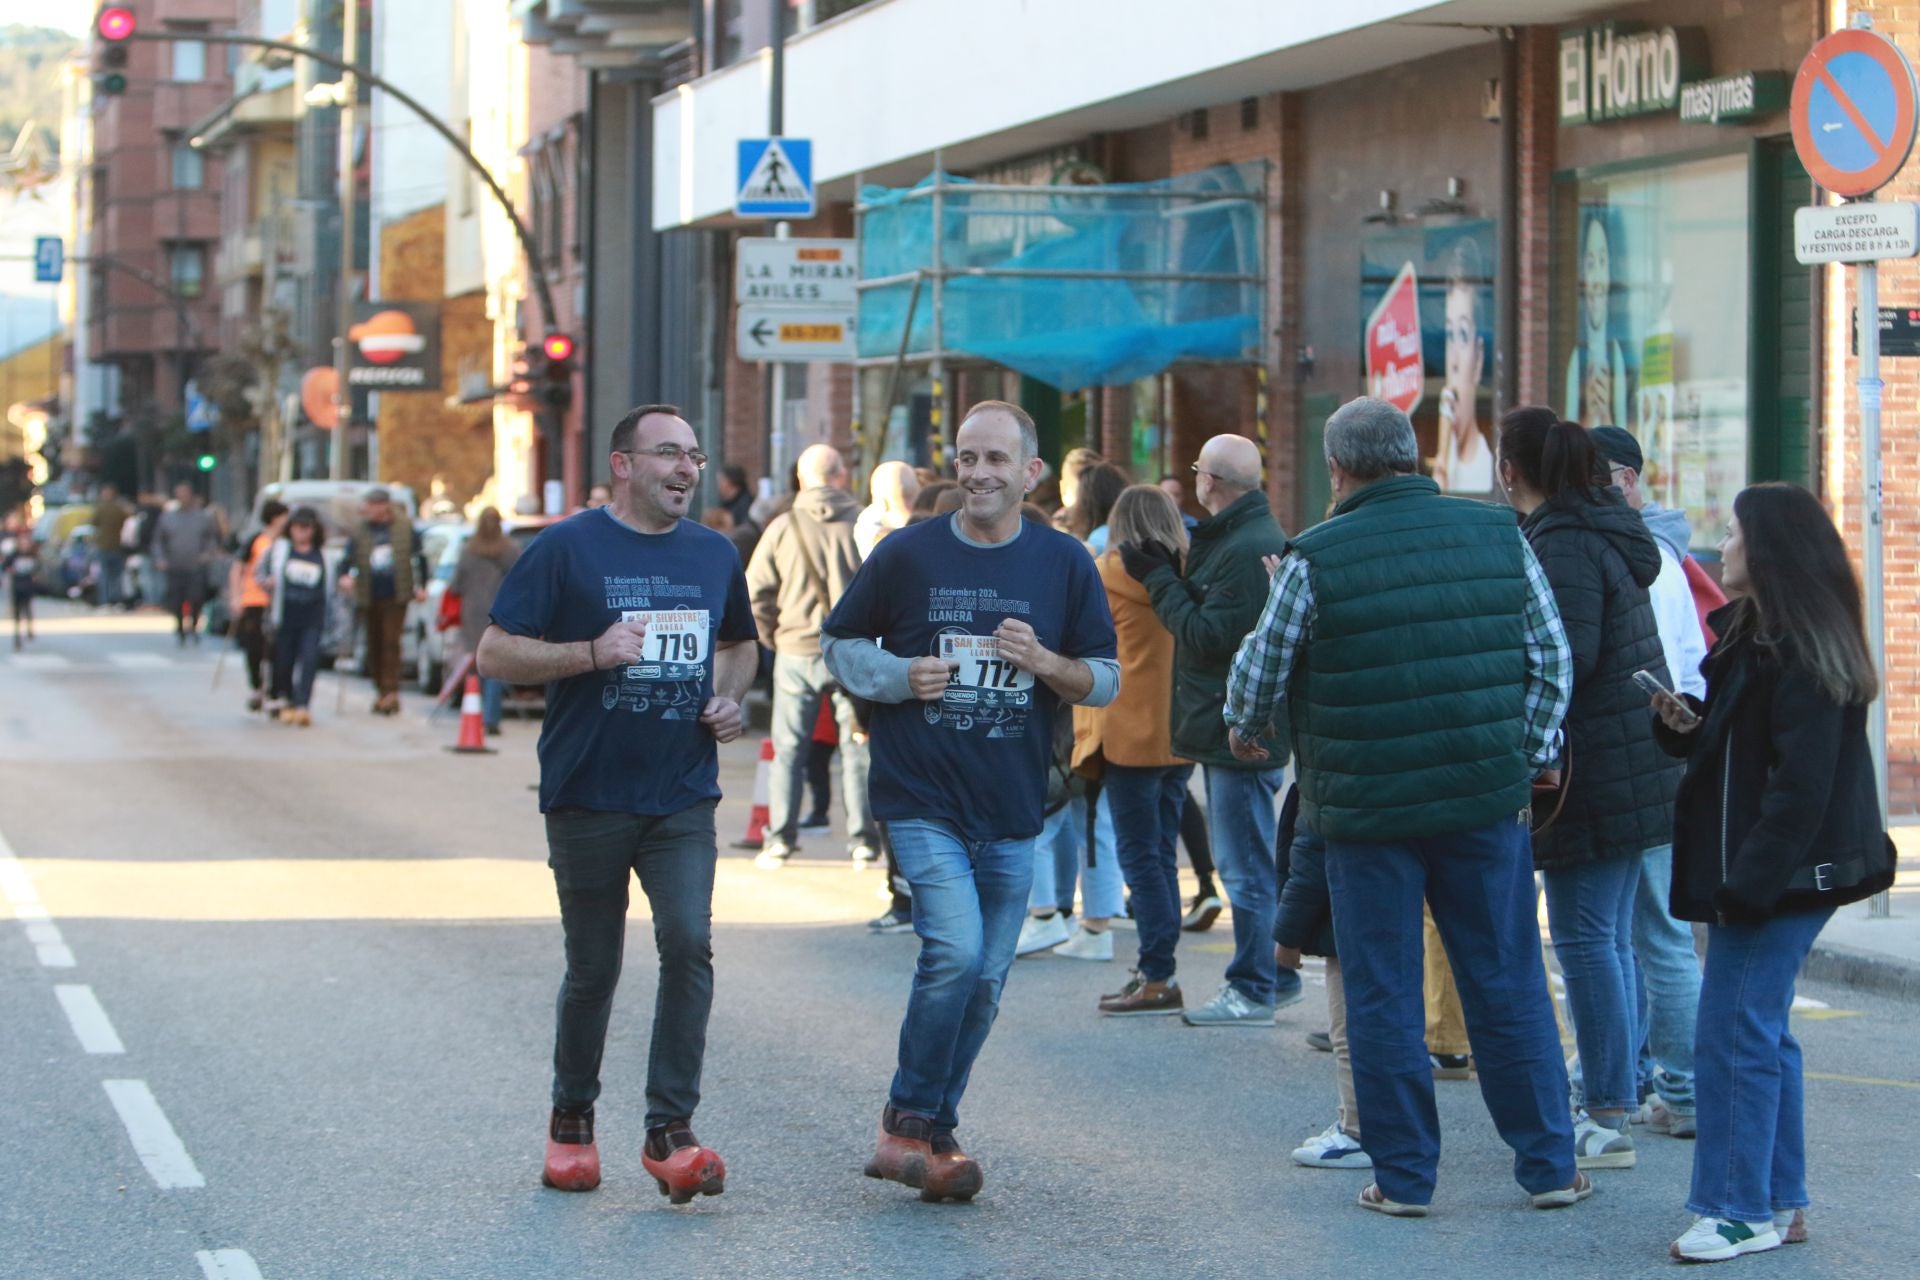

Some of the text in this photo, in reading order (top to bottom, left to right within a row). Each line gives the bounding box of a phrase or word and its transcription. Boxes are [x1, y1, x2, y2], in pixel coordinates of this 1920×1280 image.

[1560, 26, 1680, 118] El Horno
[1680, 73, 1754, 124] masymas
[1835, 213, 1877, 226] EXCEPTO
[1802, 244, 1808, 254] Y
[1810, 242, 1853, 254] FESTIVOS
[1855, 241, 1869, 252] DE
[1885, 240, 1893, 250] A
[745, 264, 772, 278] LA
[747, 283, 821, 298] AVILES
[604, 575, 669, 584] 31 diciembre 2024
[929, 588, 997, 598] 31 diciembre 2024
[607, 597, 650, 609] LLANERA
[955, 597, 977, 611] SAN
[979, 599, 1030, 614] SILVESTRE
[656, 612, 697, 623] SILVESTRE
[928, 611, 973, 622] LLANERA
[651, 623, 684, 631] LLANERA
[656, 633, 697, 661] 779
[954, 637, 1001, 648] SAN SILVE
[975, 659, 1018, 688] 772
